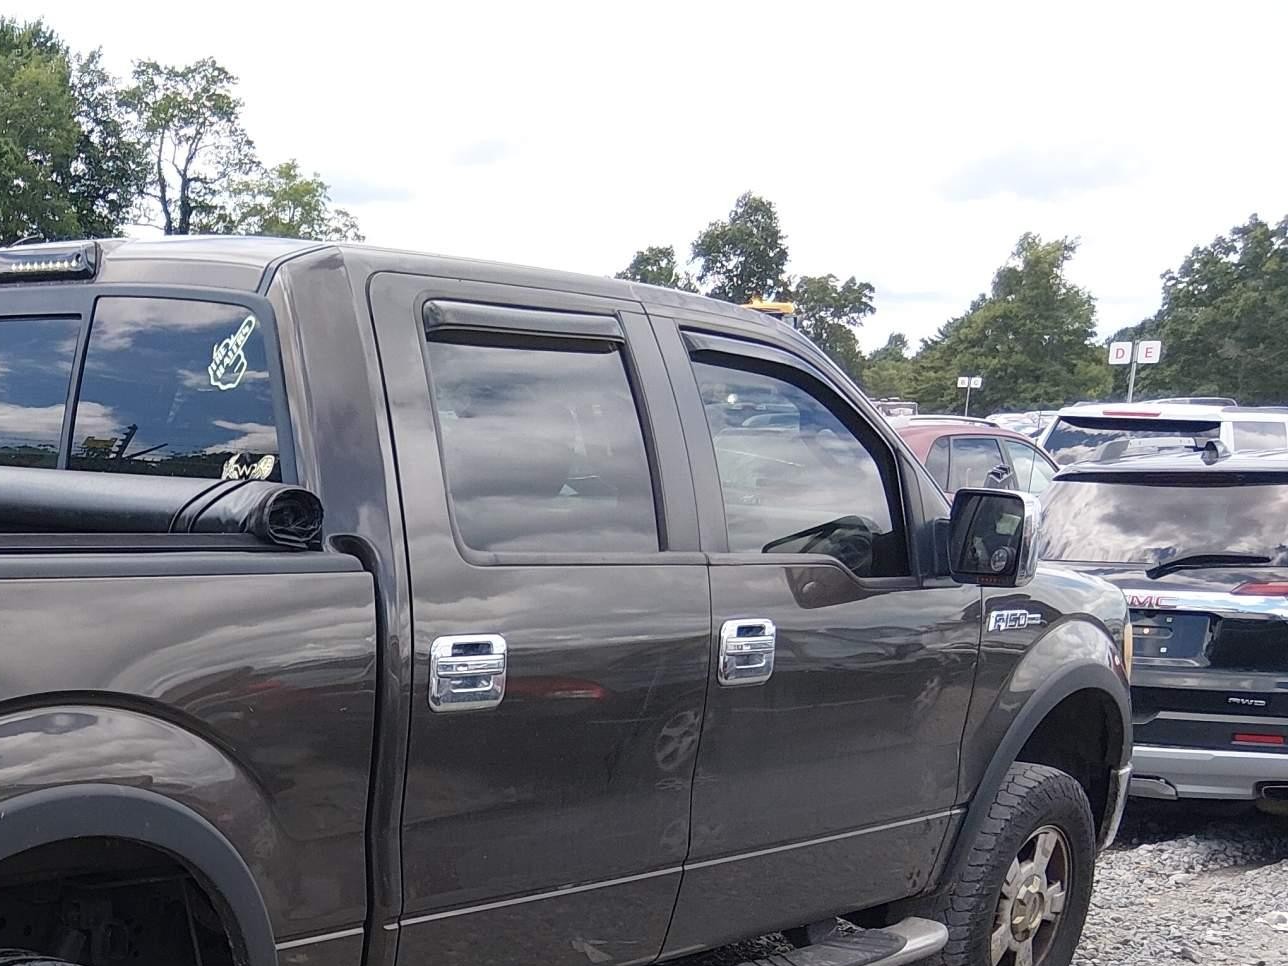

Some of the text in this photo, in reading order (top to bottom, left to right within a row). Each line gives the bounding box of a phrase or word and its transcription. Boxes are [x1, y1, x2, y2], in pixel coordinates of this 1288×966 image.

[1115, 347, 1125, 359] D
[1144, 347, 1153, 358] E
[1228, 697, 1266, 706] AWD
